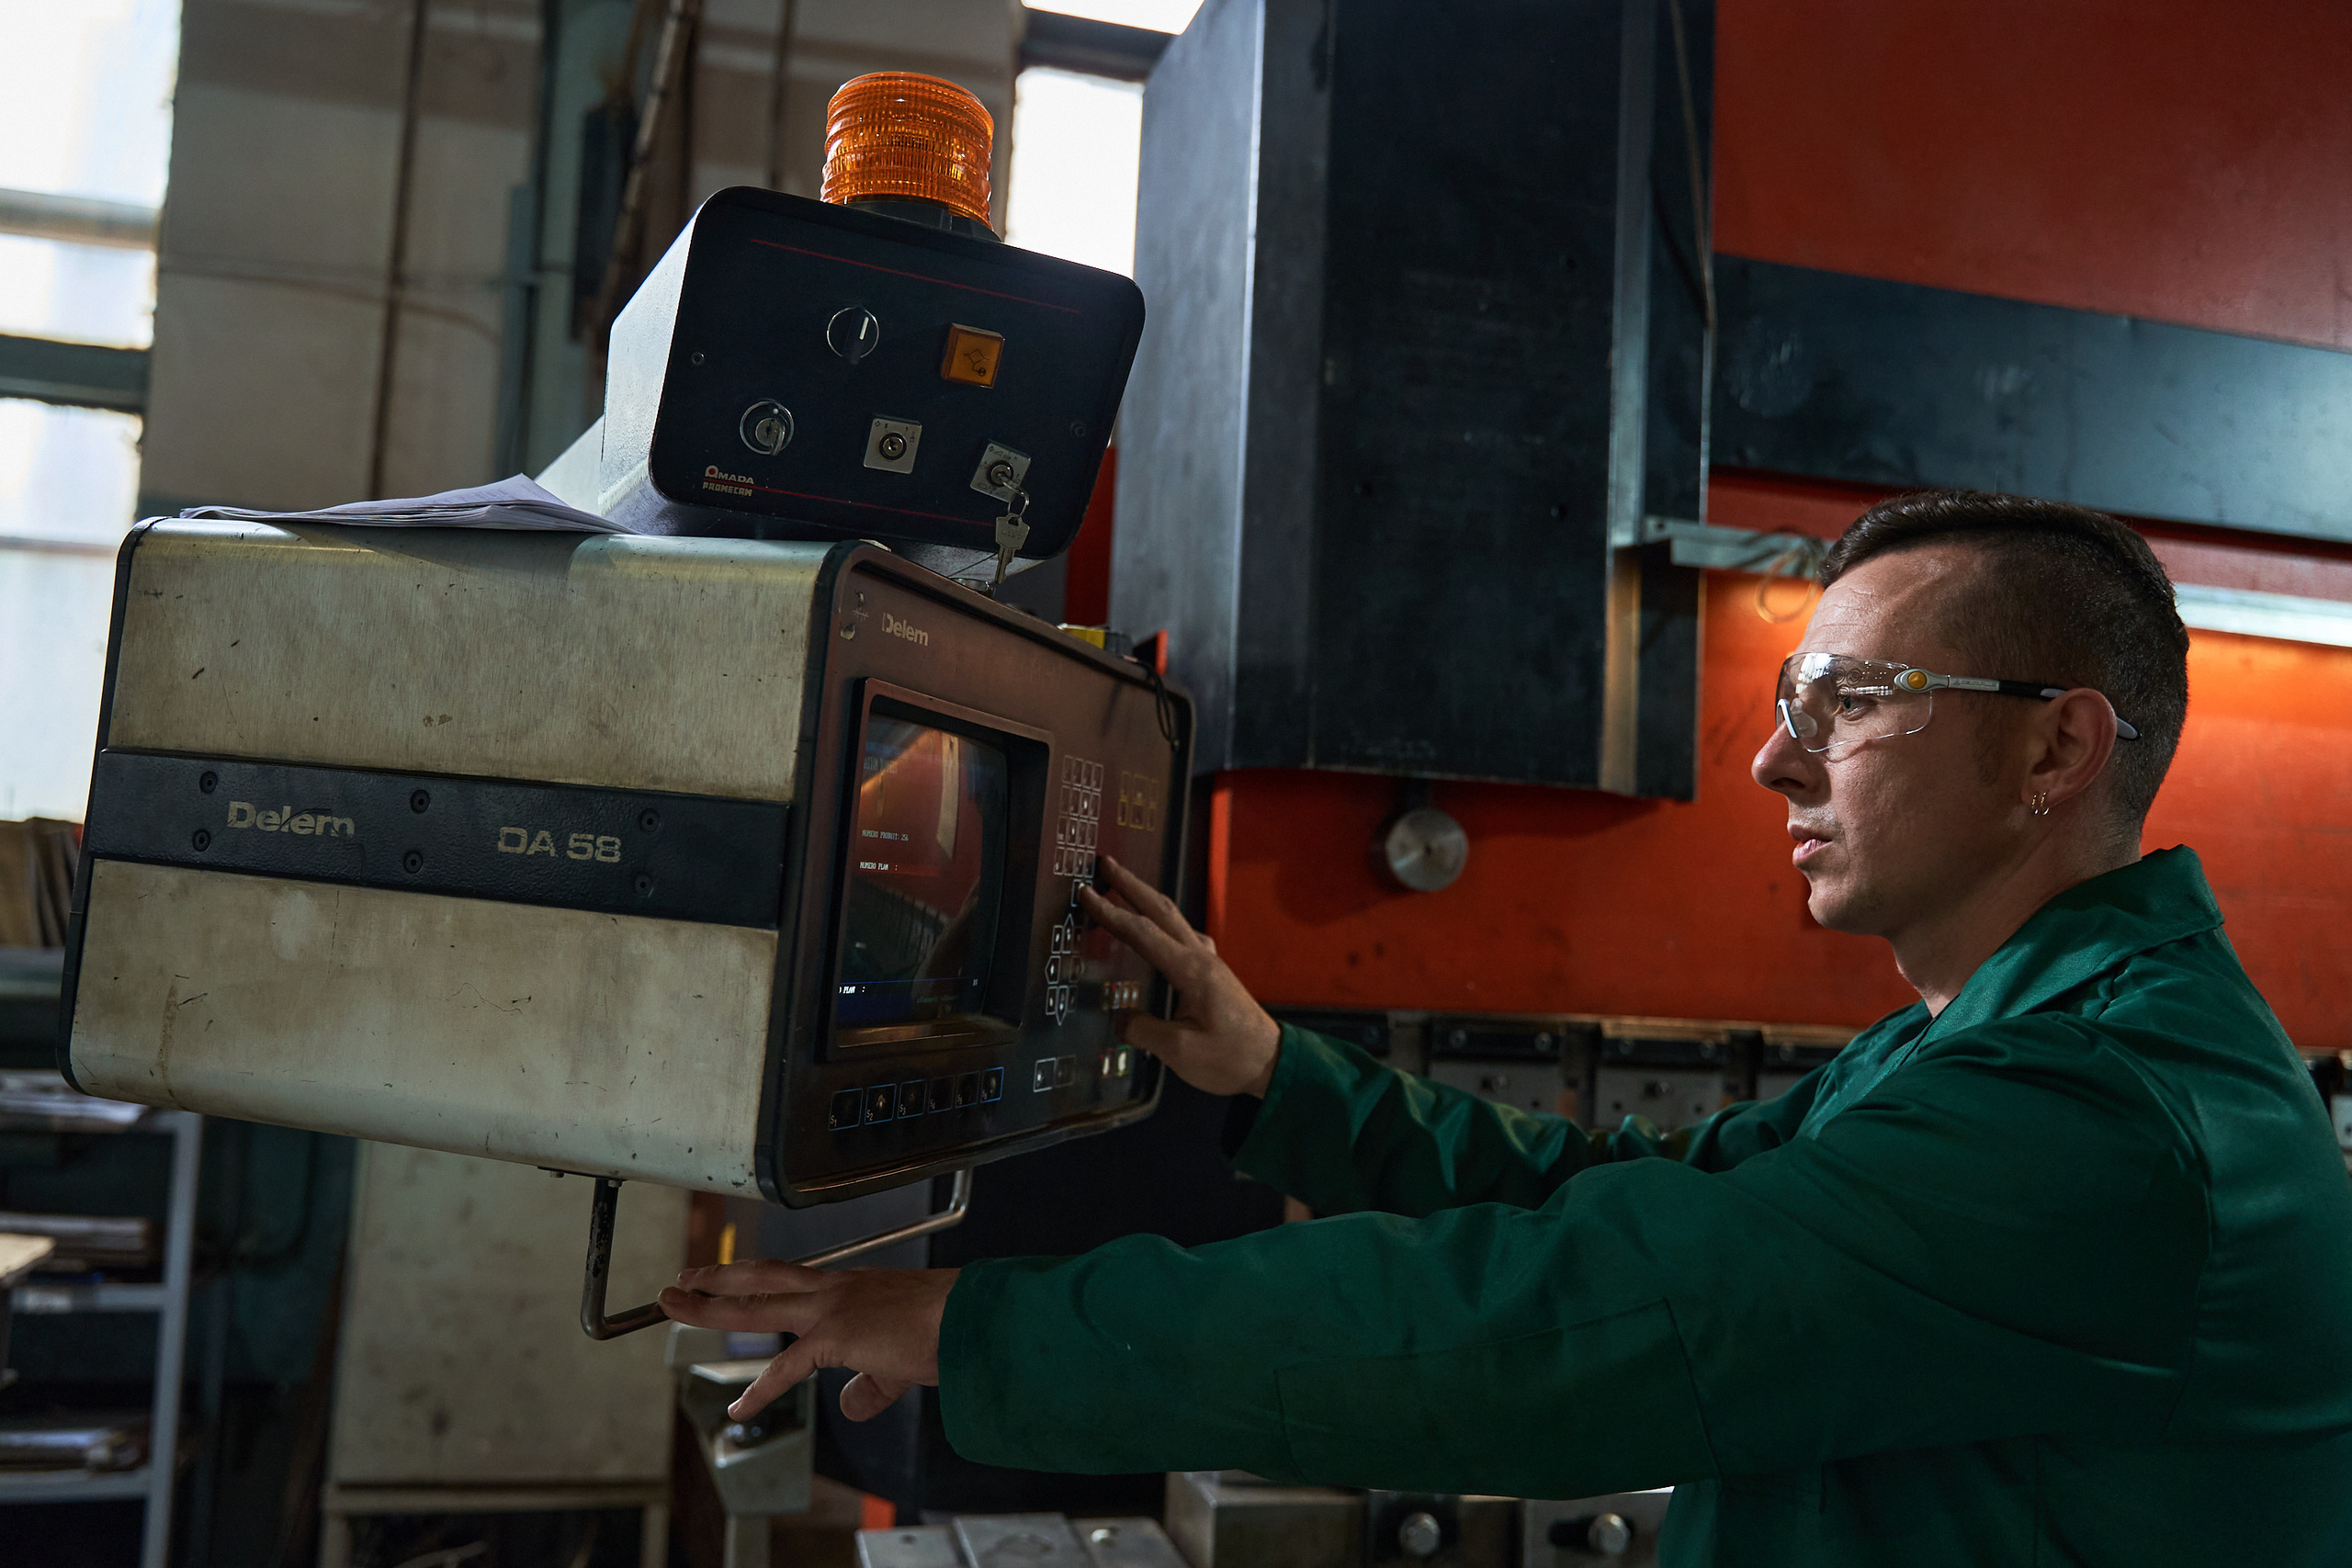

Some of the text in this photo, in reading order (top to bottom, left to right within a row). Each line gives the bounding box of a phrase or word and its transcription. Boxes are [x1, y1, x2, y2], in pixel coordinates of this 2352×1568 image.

[705, 465, 754, 485] AMADA
[702, 481, 753, 497] PROMECAM
[882, 612, 929, 647] Delem
[226, 800, 622, 863] Delem DA 58
[862, 829, 878, 838] NUMERO
[859, 862, 876, 870] NUMERO
[877, 863, 888, 871] PLAN
[842, 986, 855, 994] PLAN
[866, 1109, 874, 1122] S2
[899, 1103, 907, 1115] S3
[830, 1114, 837, 1127] S1
